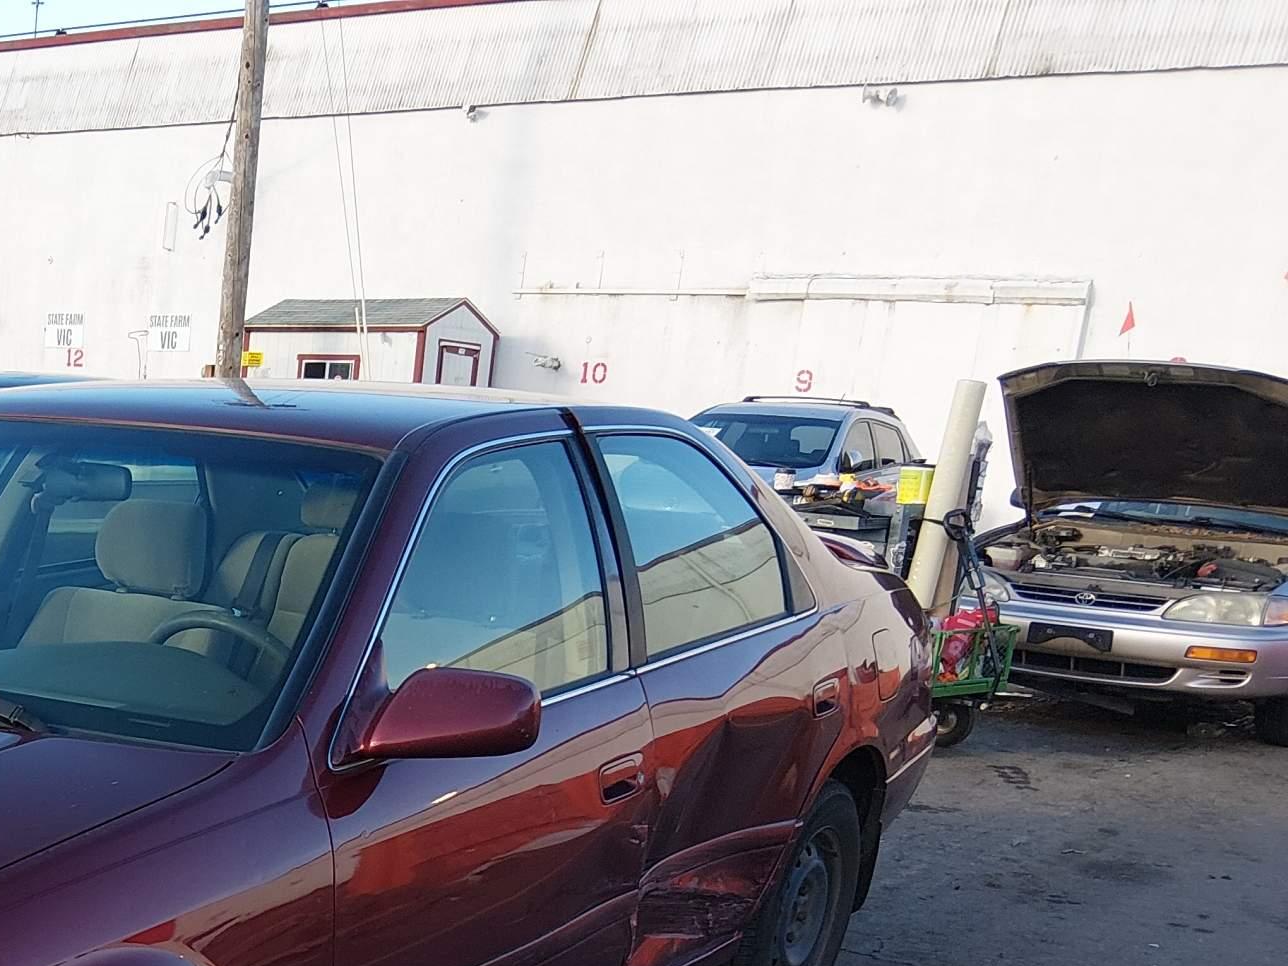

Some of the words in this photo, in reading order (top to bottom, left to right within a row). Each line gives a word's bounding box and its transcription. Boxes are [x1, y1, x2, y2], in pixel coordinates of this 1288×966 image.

[47, 313, 64, 326] STATE
[65, 313, 83, 326] FARM
[149, 315, 169, 328] STATE
[170, 315, 190, 328] FARM
[56, 328, 73, 346] VIC
[160, 331, 178, 350] VIC
[66, 348, 84, 367] 12
[580, 361, 608, 384] 10
[795, 369, 813, 393] 9
